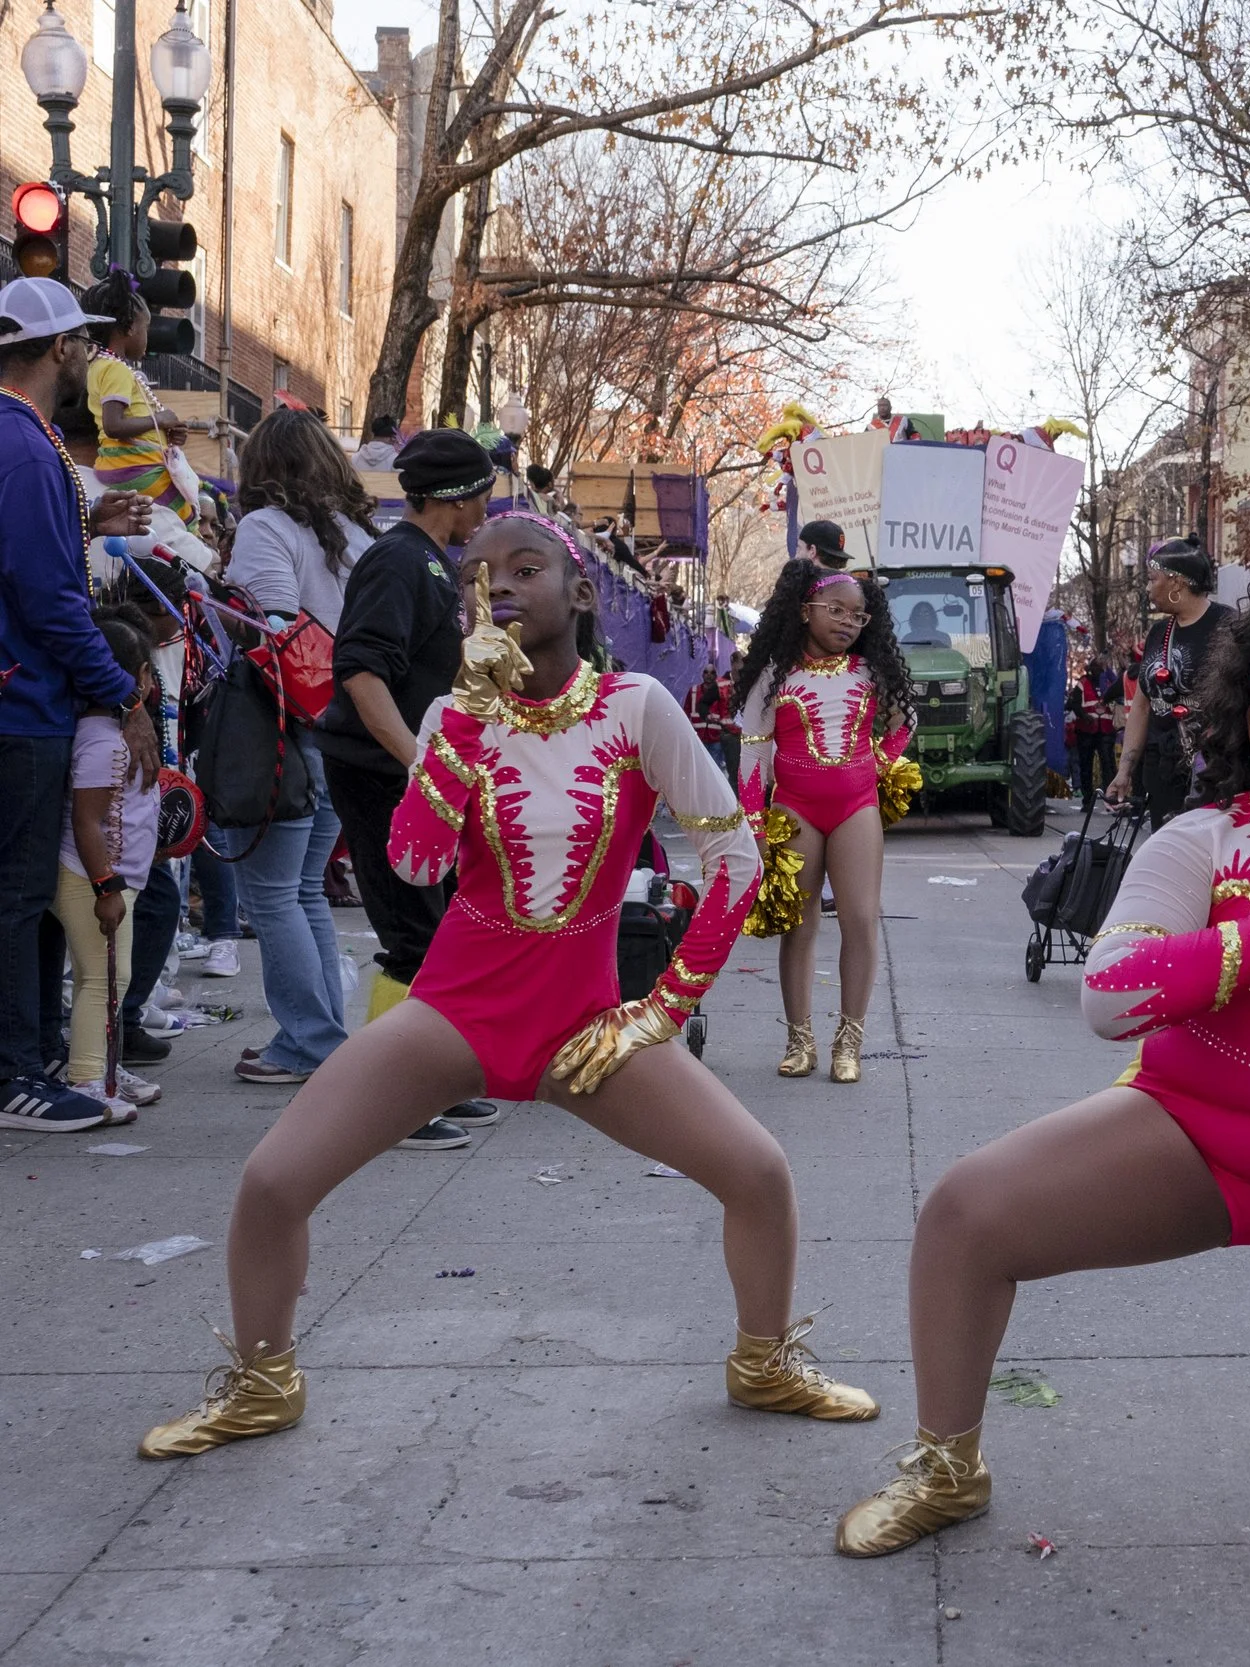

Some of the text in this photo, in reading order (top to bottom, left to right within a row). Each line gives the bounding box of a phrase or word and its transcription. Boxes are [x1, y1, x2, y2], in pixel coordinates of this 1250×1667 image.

[803, 447, 826, 474] Q
[997, 444, 1017, 474] Q
[809, 486, 829, 496] What
[987, 478, 1006, 490] What
[813, 499, 834, 509] walks
[834, 495, 847, 503] like
[984, 492, 1027, 509] runs around
[815, 510, 843, 521] Quacks
[843, 507, 856, 516] like
[988, 506, 1023, 522] confusion
[1023, 516, 1029, 524] &
[1030, 519, 1060, 533] distress
[885, 520, 974, 552] TRIVIA
[982, 518, 1045, 541] uring Mardi Gras?
[971, 586, 983, 596] 05
[1012, 582, 1034, 592] veler
